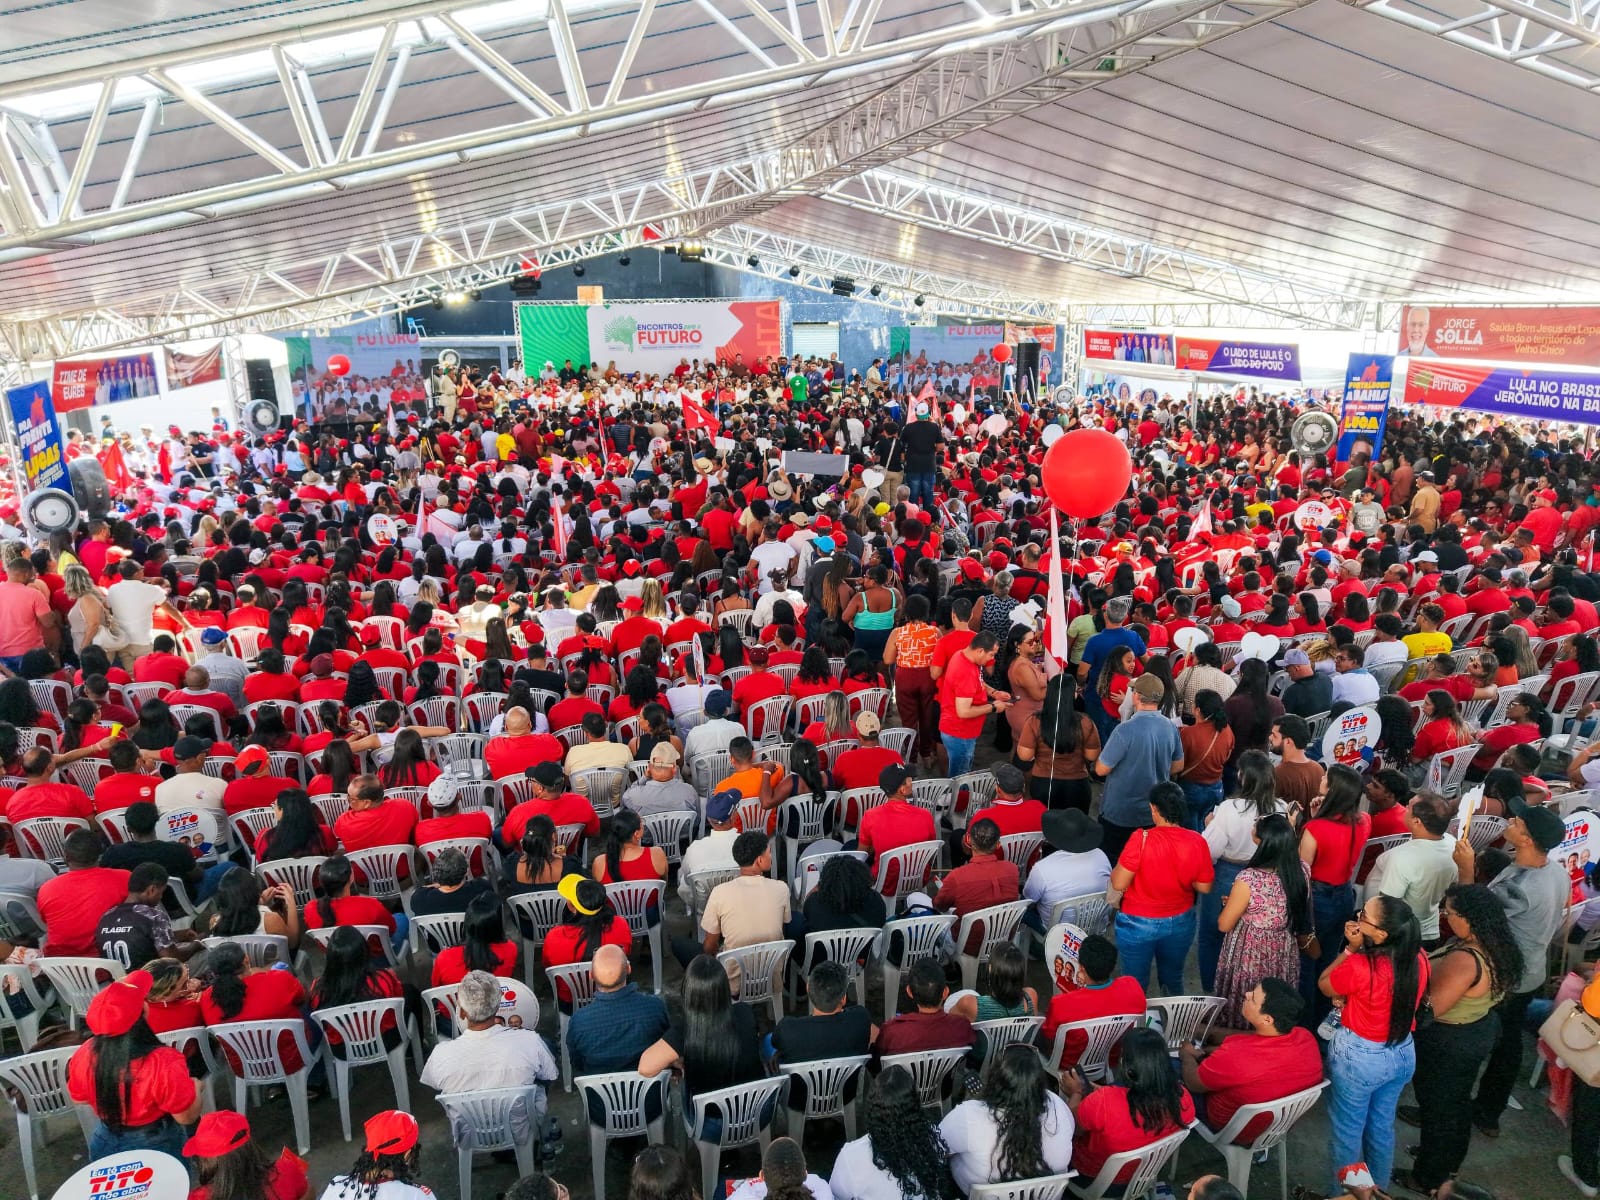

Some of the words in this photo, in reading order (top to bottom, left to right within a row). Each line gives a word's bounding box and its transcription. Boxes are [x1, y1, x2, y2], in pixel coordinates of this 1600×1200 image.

[1443, 318, 1477, 329] JORGE
[1537, 324, 1563, 333] Jesus
[637, 329, 703, 344] FUTURO
[1434, 328, 1483, 345] SOLLA
[1506, 335, 1525, 343] todo
[1534, 335, 1571, 345] território
[1573, 336, 1585, 345] do
[1224, 347, 1229, 356] O
[1230, 348, 1248, 357] LADO
[1249, 349, 1258, 358] DE
[1260, 349, 1277, 359] LULA
[1278, 349, 1283, 360] É
[1285, 351, 1291, 361] O
[1515, 344, 1538, 354] Velho
[1539, 345, 1565, 355] Chico
[1230, 358, 1249, 367] LADO
[1249, 360, 1261, 369] DO
[1262, 361, 1284, 371] POVO
[78, 368, 87, 382] DE
[1432, 380, 1467, 393] FUTURO
[1509, 378, 1536, 392] LULA
[1539, 380, 1558, 394] NO
[1561, 382, 1600, 398] BRASI
[1495, 390, 1560, 407] JERÔNIMO
[1563, 397, 1579, 410] NA
[101, 926, 133, 934] FLABET
[102, 940, 131, 969] 10
[120, 1163, 141, 1171] com
